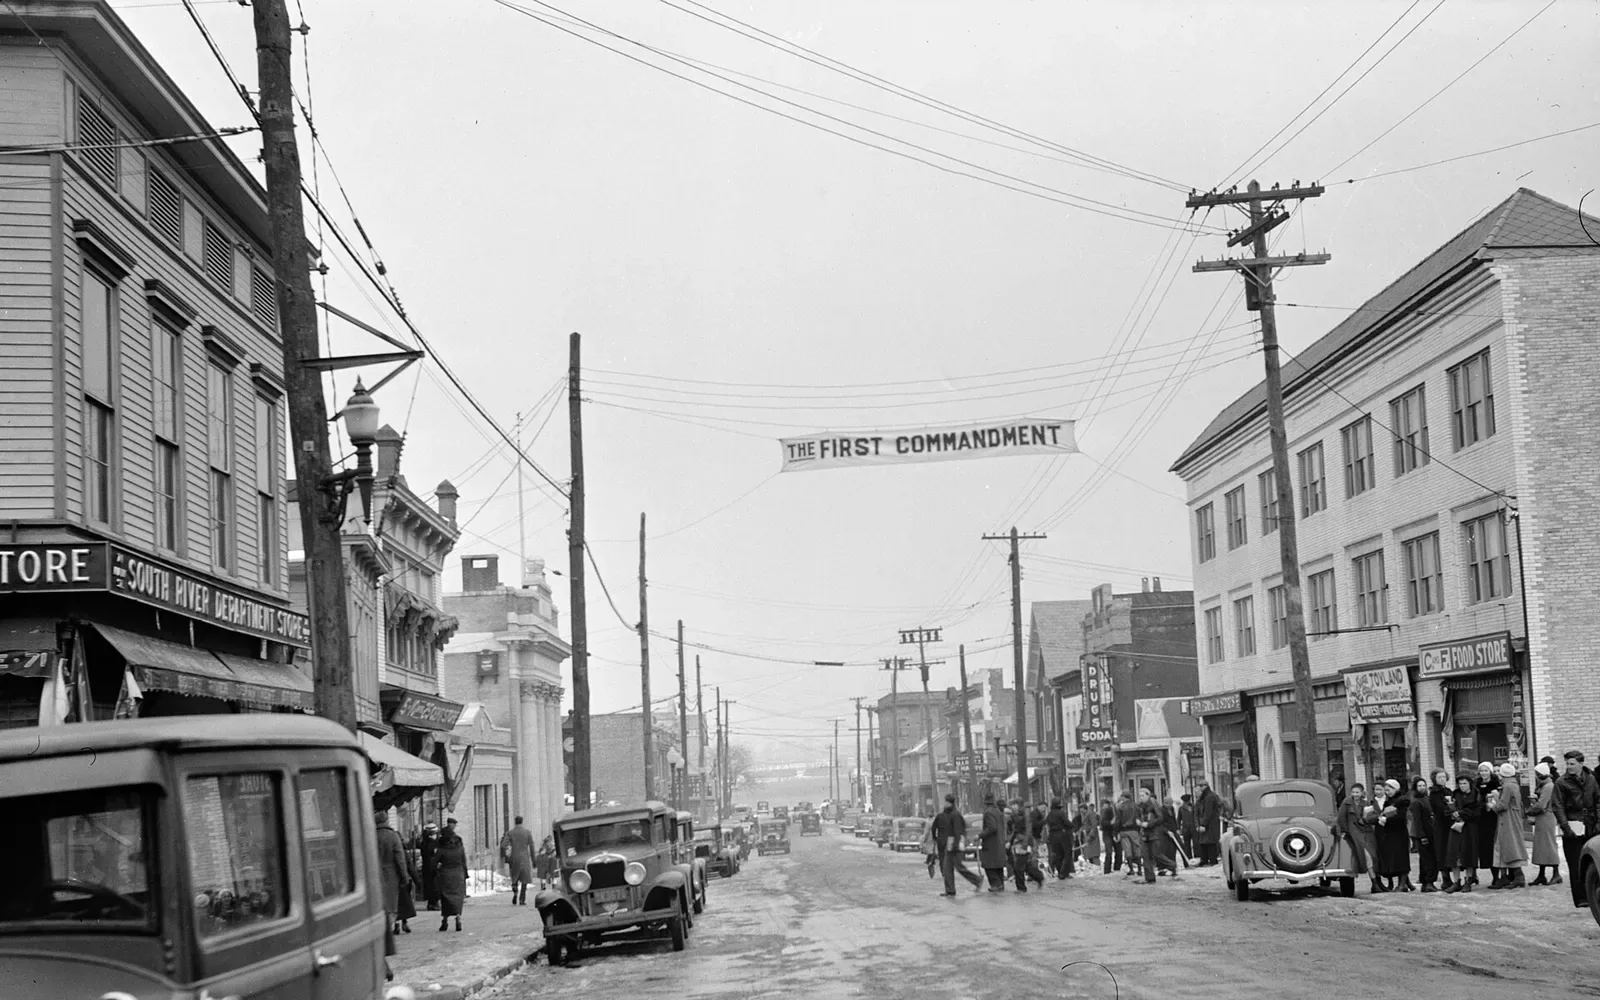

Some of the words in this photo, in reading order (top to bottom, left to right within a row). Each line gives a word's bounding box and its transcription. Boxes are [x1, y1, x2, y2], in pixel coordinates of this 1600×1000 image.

[787, 442, 816, 459] THE
[820, 437, 883, 459] FIRST
[895, 425, 1061, 454] COMMANDMENT
[128, 559, 169, 601] SOUTH
[175, 575, 209, 614] RIVER
[215, 591, 275, 633] DEPARTMENT
[277, 611, 303, 640] STORE
[1452, 644, 1475, 669] FOOD
[1476, 639, 1508, 665] STORE
[1369, 668, 1403, 688] TOYLAND
[1088, 666, 1101, 728] DRUGS
[1081, 731, 1112, 741] SODA
